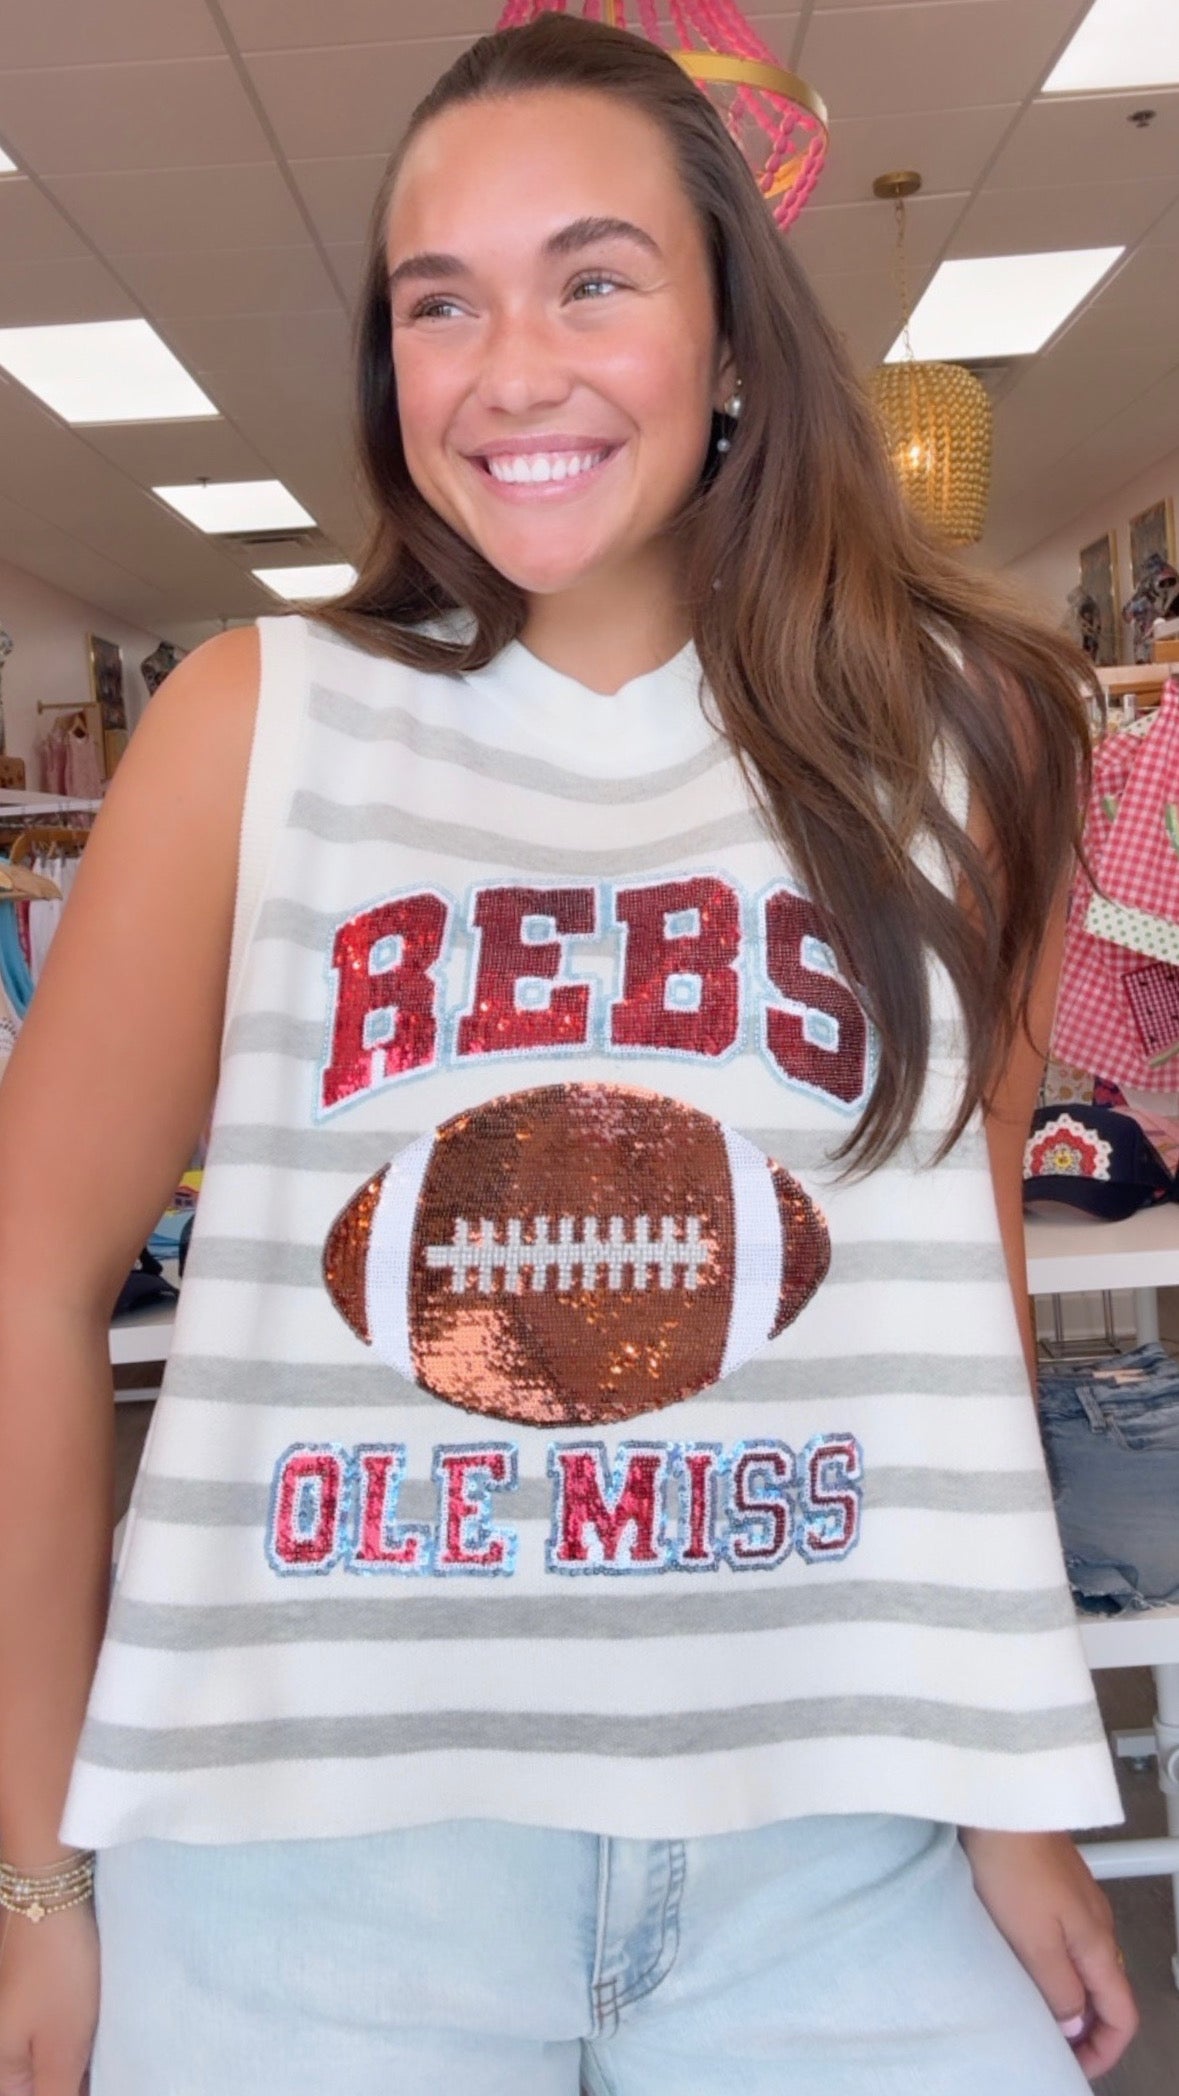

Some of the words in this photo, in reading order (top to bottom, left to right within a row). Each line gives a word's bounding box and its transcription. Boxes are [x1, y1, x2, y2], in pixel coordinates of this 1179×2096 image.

[315, 869, 880, 1121] REBS
[265, 1441, 518, 1577] OLE
[545, 1432, 864, 1576] MISS
